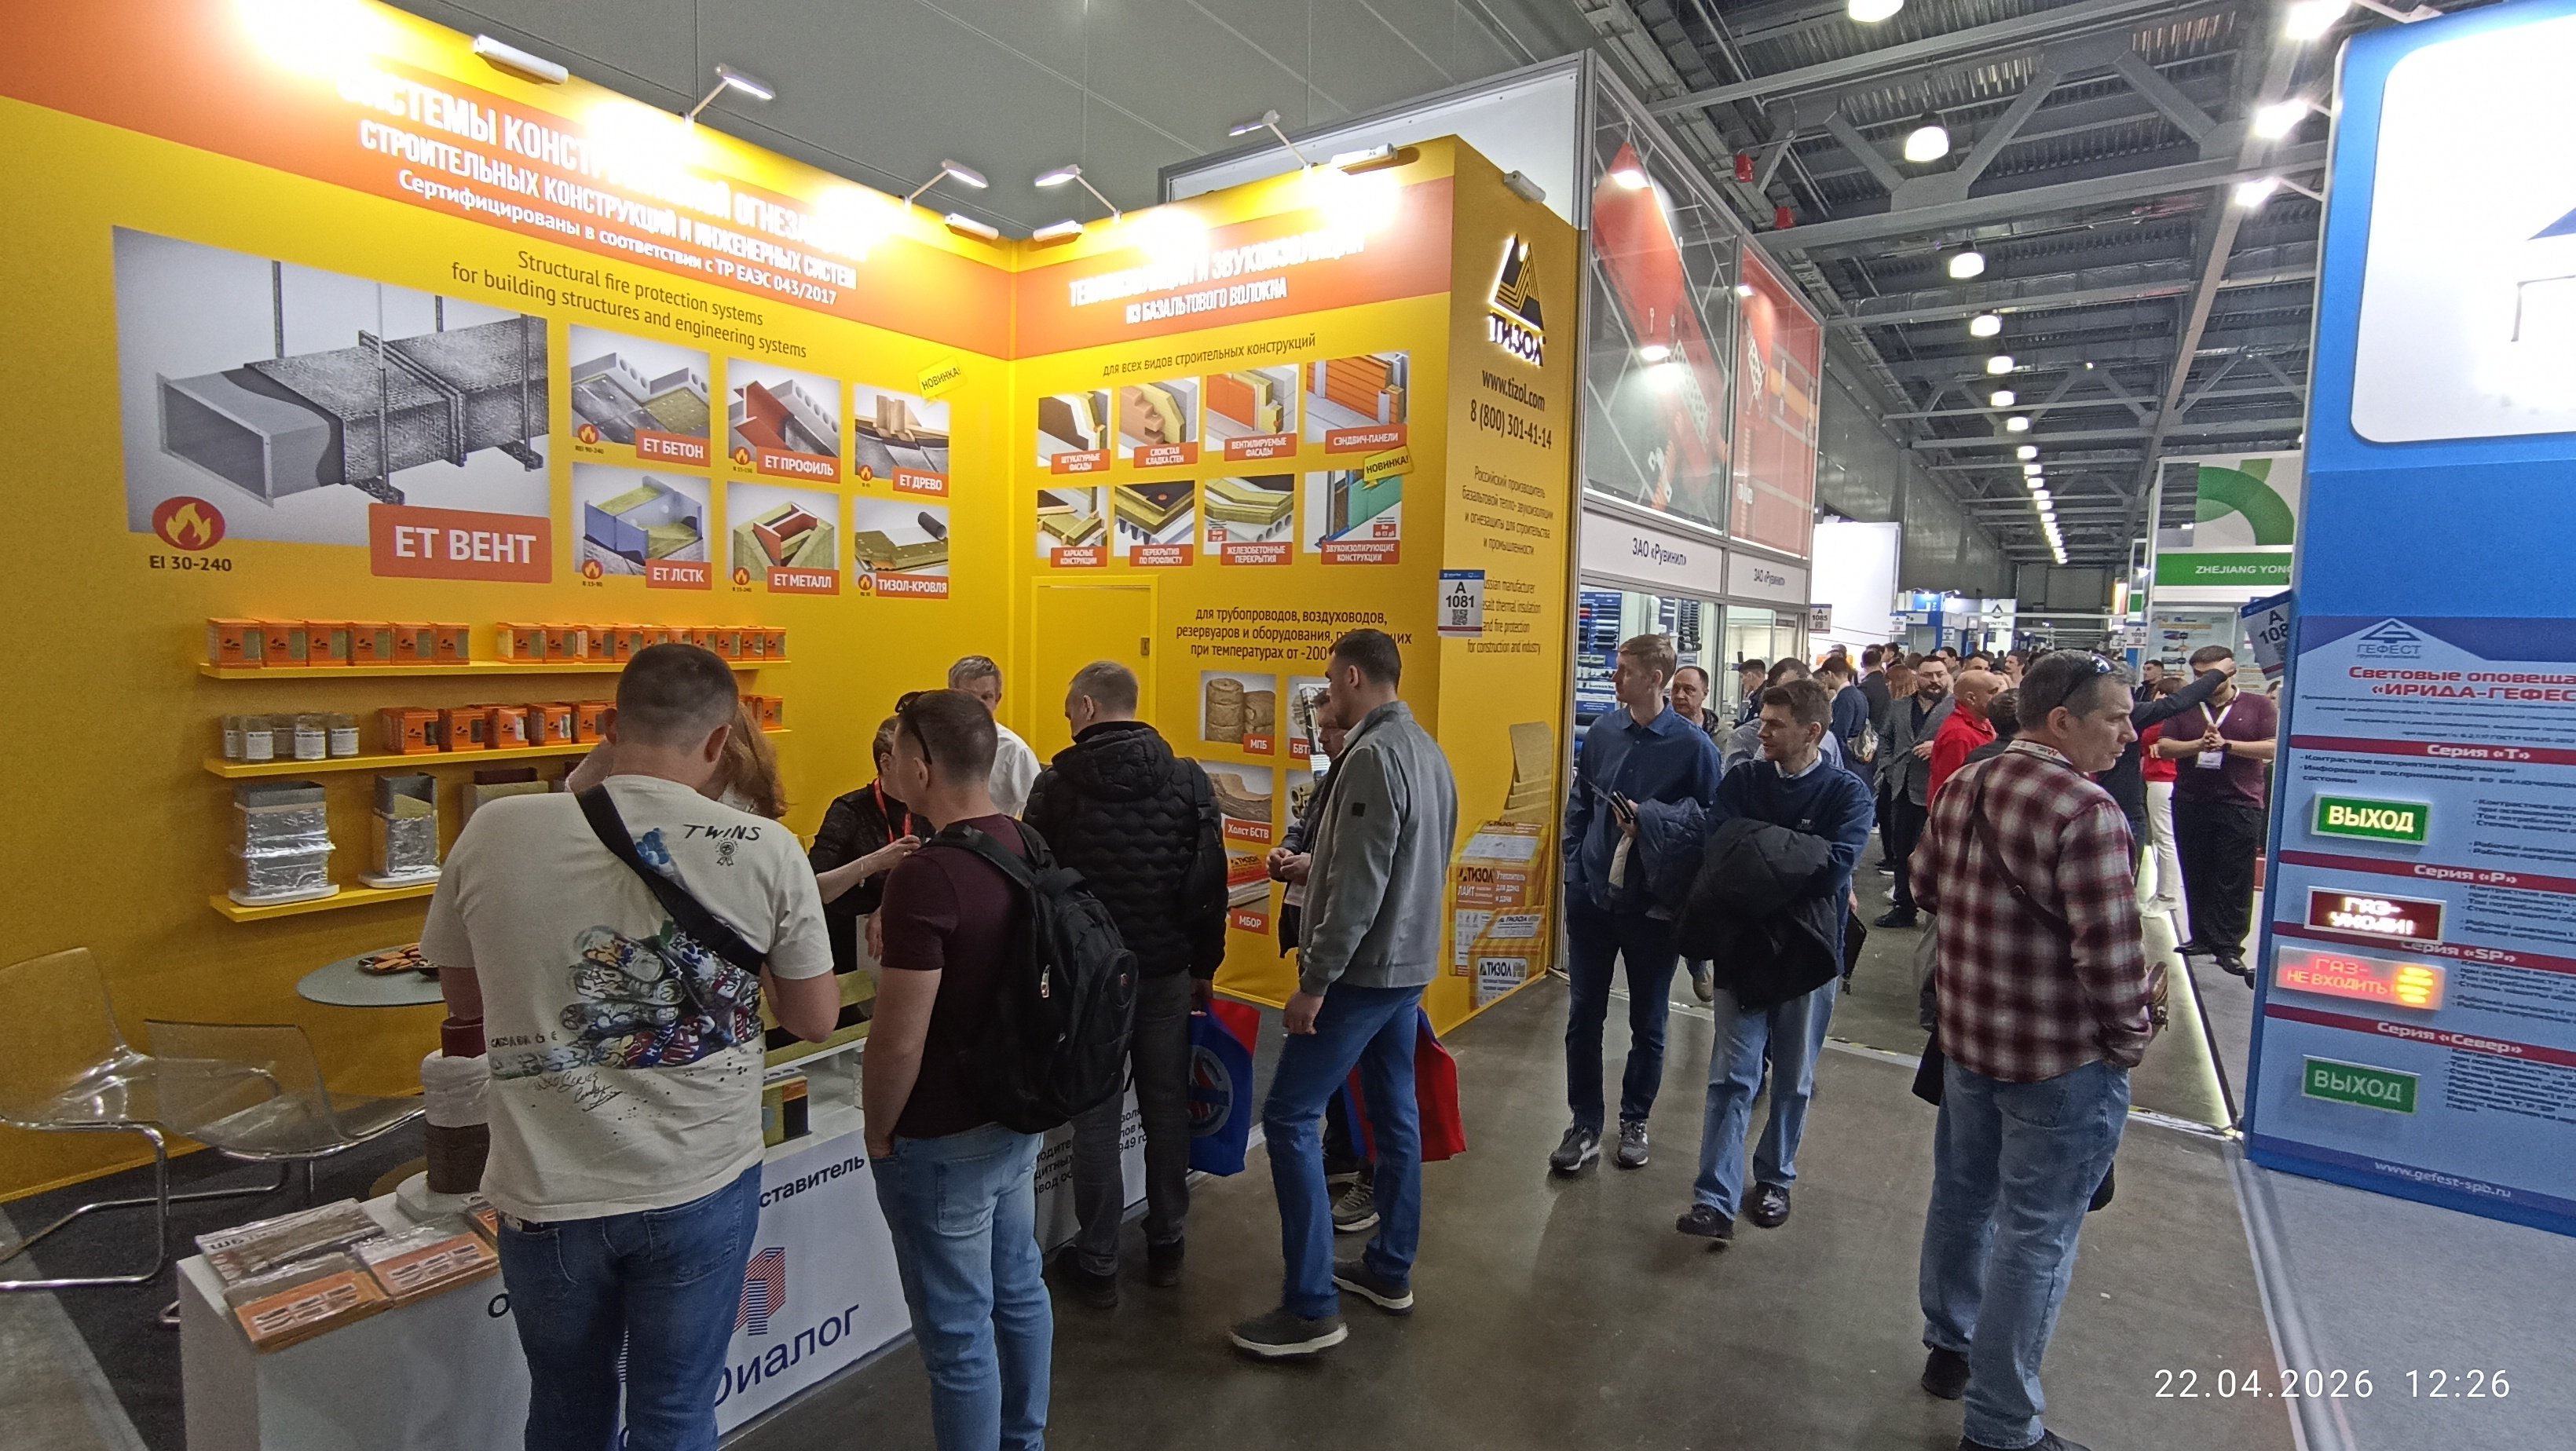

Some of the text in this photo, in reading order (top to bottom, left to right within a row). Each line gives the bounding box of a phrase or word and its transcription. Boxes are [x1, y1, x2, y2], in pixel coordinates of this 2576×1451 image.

[336, 72, 498, 147] СТЕМЫ
[360, 119, 540, 198] СТРОИТЕЛЬНЫХ
[544, 176, 677, 238] КОНСТРУКЦИЙ
[679, 217, 692, 242] И
[694, 221, 802, 274] ИНЖЕНЕРНЫХ
[398, 169, 837, 305] Сертифицированы в соответствии с ТР ЕАЭС 043/2017
[518, 250, 763, 327] Structural fire protection systems
[1142, 287, 1228, 323] БАЗАЛЬТОВОГО
[1228, 277, 1287, 305] ВОЛОКНА
[452, 262, 807, 359] for building structures and engineering systems
[1488, 312, 1547, 367] ТИЗОЛ
[1103, 333, 1316, 377] для всех видов строительных конструкций
[1482, 370, 1545, 412] www.tizol.com
[1470, 399, 1552, 449] 8 (800) 301-41-14
[662, 440, 704, 459] БЕТОН
[1231, 437, 1287, 450] ВЕНТИЛИРУЕМЫЕ
[1333, 433, 1399, 447] СЭНДВИЧ-ПАНЕЛИ
[781, 457, 834, 477] ПРОФИЛЬ
[1366, 455, 1410, 474] НОВИНКА!
[913, 477, 942, 491] ДРЕВО
[448, 528, 537, 564] ВЕНТ
[1632, 537, 1687, 567] ЗАО «Рувинил»
[149, 554, 232, 572] EI 30-240
[1235, 554, 1277, 564] ПЕРЕКРЫТИЯ
[671, 568, 704, 583] ЛСТК
[2195, 565, 2256, 575] ZHEJIANG
[789, 574, 832, 588] МЕТАЛЛ
[877, 578, 947, 594] ТИЗОЛ-КРОВЛЯ
[1454, 581, 1467, 594] A
[1484, 579, 1501, 590] ussian
[1445, 594, 1475, 609] 1081
[1195, 607, 1388, 626] для трубопроводов, воздуховодов,
[2269, 609, 2284, 626] A
[1176, 626, 1240, 642] резервуаров
[1242, 629, 1250, 639] и
[1252, 627, 1334, 644] оборудования,
[2259, 623, 2289, 645] 108
[1191, 644, 1327, 661] при температурах от -200
[2356, 643, 2422, 654] ГЕФЕСТ
[2348, 666, 2462, 682] Световые
[1250, 739, 1268, 750] МПБ
[2427, 744, 2530, 759] Серия «Т»
[2328, 805, 2414, 833] ВЫХОД
[682, 823, 762, 842] TWINS
[1228, 823, 1270, 839] Холст БСТВ
[2413, 864, 2474, 881] Серия
[1239, 915, 1262, 929] МБОР
[2400, 941, 2516, 963] Серия «SP»
[2314, 958, 2369, 974] ГАЗ-
[2287, 970, 2388, 996] НЕ ВХОДИТЬ
[2377, 1022, 2523, 1054] Серия «Север»
[2313, 1069, 2403, 1103] ВЫХОД
[1119, 1139, 1136, 1153] 949
[759, 1154, 865, 1208] ставитель
[2374, 1160, 2512, 1199] www.gefest-spb.ru
[715, 1303, 860, 1409] иалог
